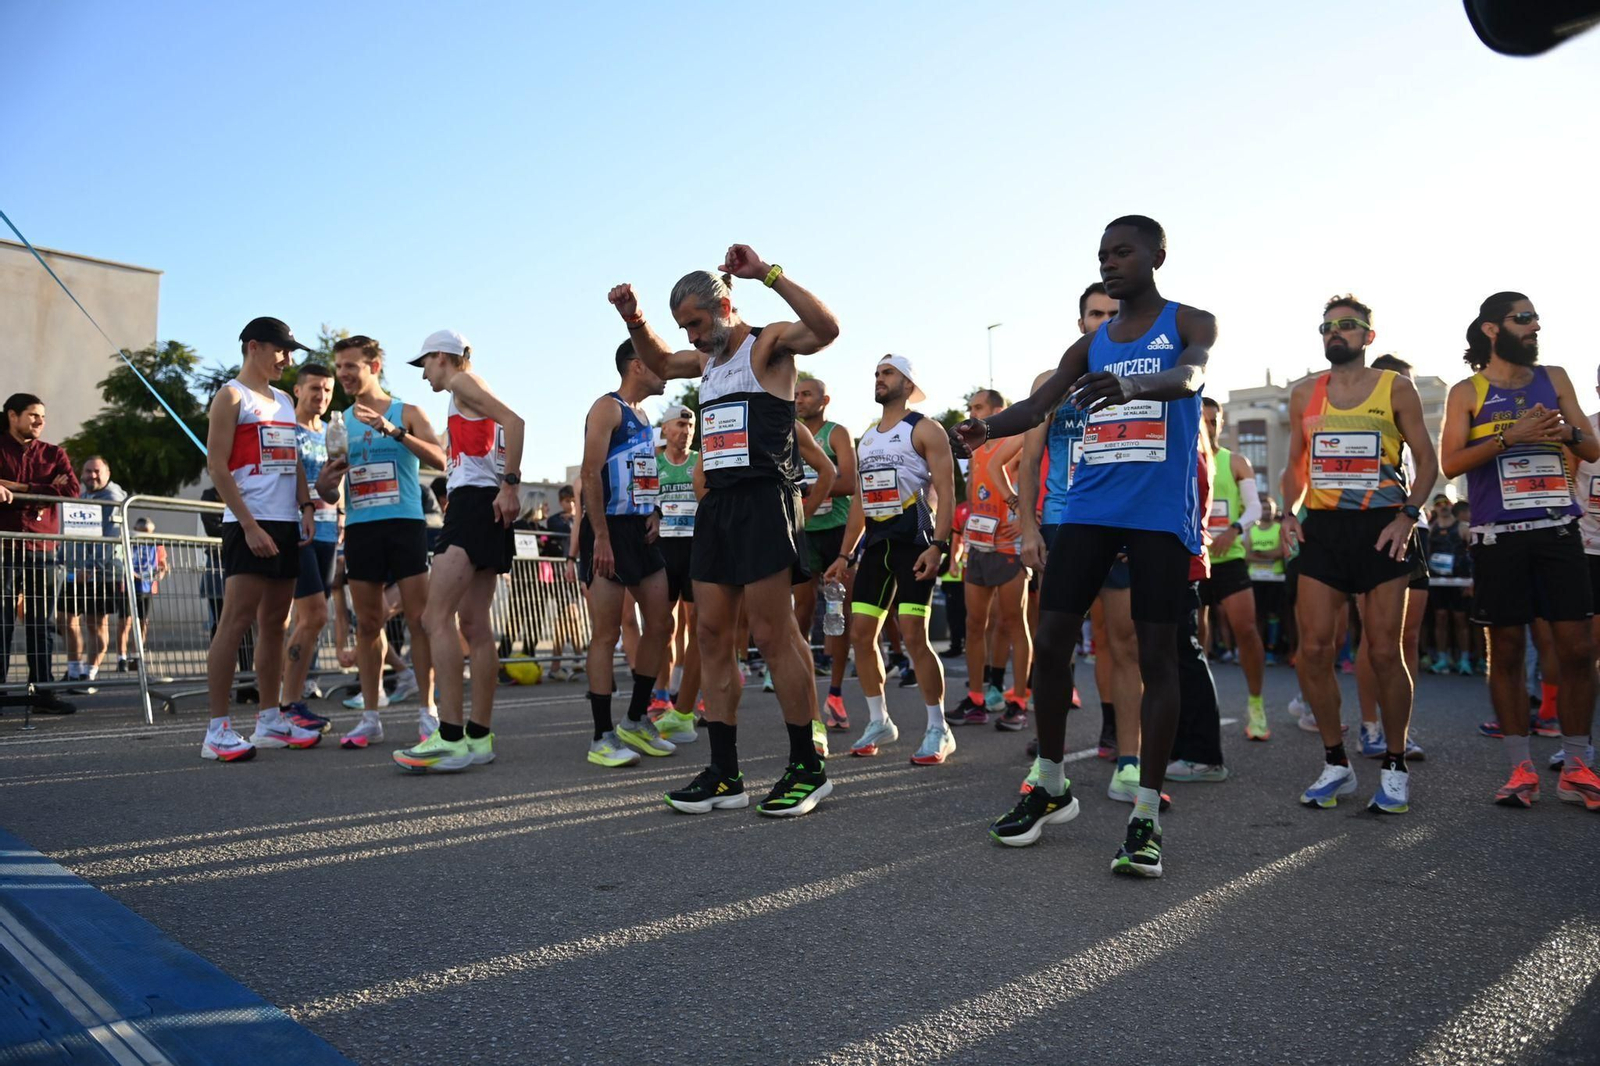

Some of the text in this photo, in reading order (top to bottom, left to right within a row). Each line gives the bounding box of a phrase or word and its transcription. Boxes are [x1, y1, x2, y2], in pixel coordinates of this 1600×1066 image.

[1117, 424, 1128, 439] 2
[712, 435, 725, 449] 33
[1335, 459, 1352, 472] 37
[1528, 478, 1546, 490] 34
[873, 492, 883, 502] 35
[673, 517, 688, 526] 153
